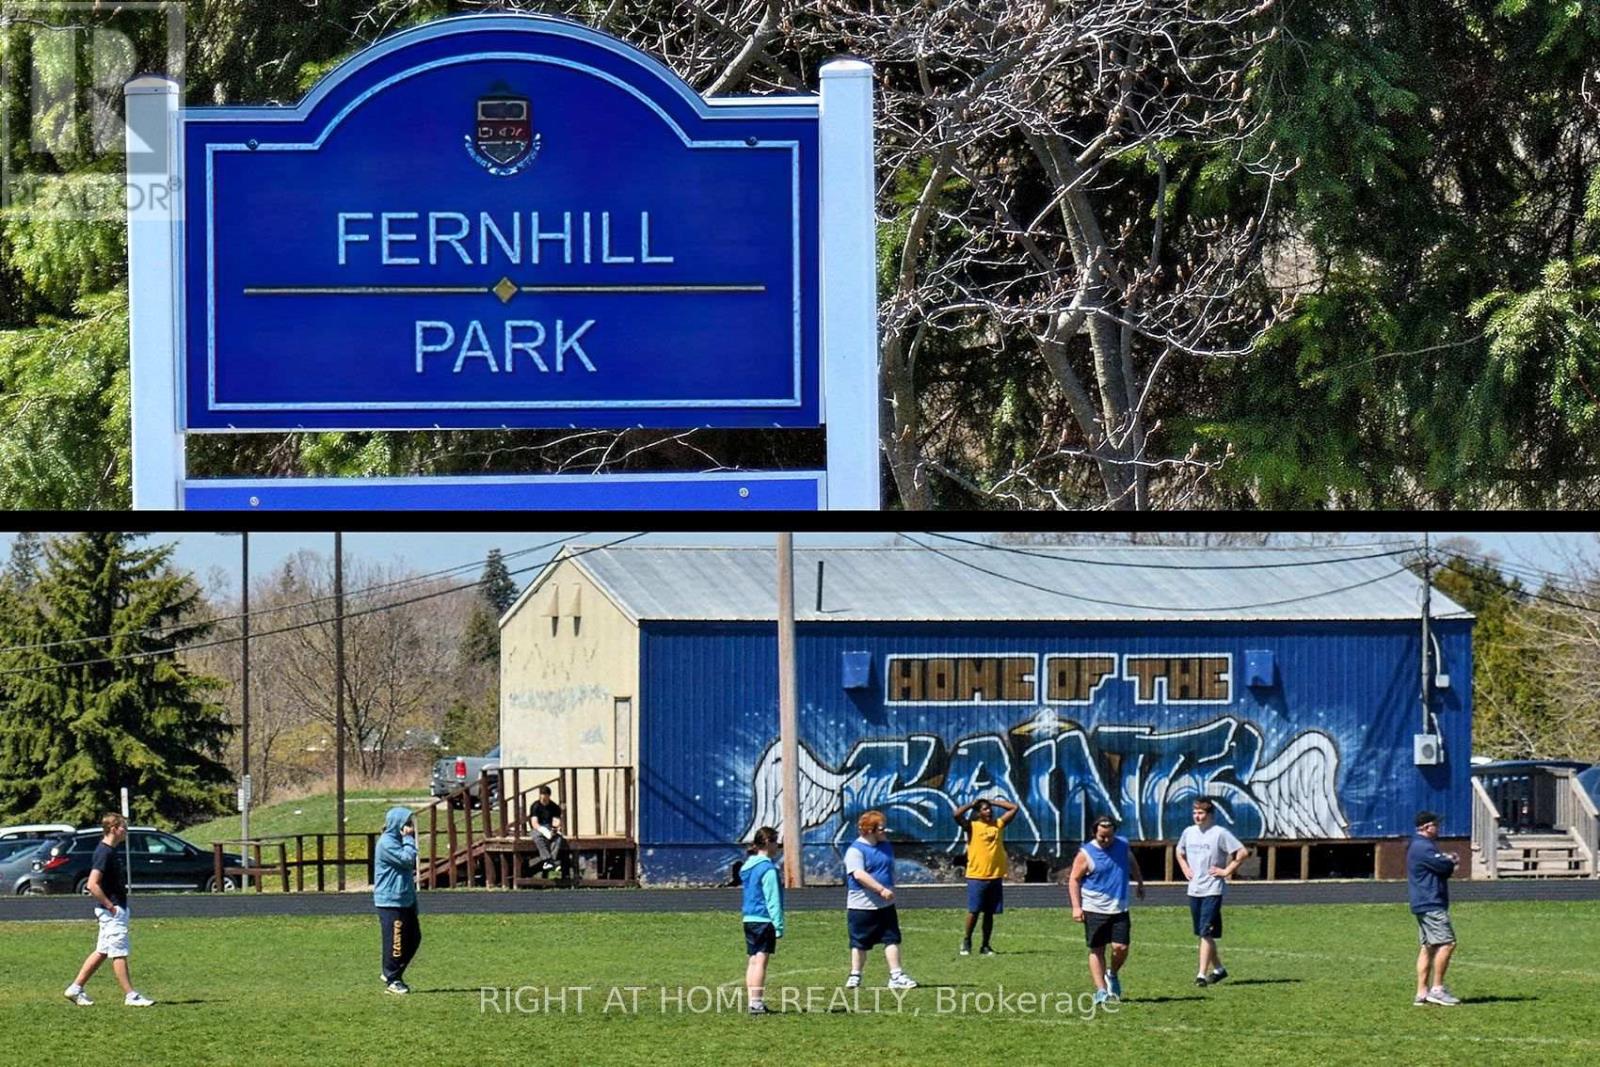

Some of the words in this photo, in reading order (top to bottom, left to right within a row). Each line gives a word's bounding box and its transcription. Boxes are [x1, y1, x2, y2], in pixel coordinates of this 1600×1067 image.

[338, 211, 674, 265] FERNHILL
[415, 319, 597, 372] PARK
[885, 653, 1039, 706] HOME
[1043, 653, 1118, 706] OF
[1123, 653, 1232, 705] THE
